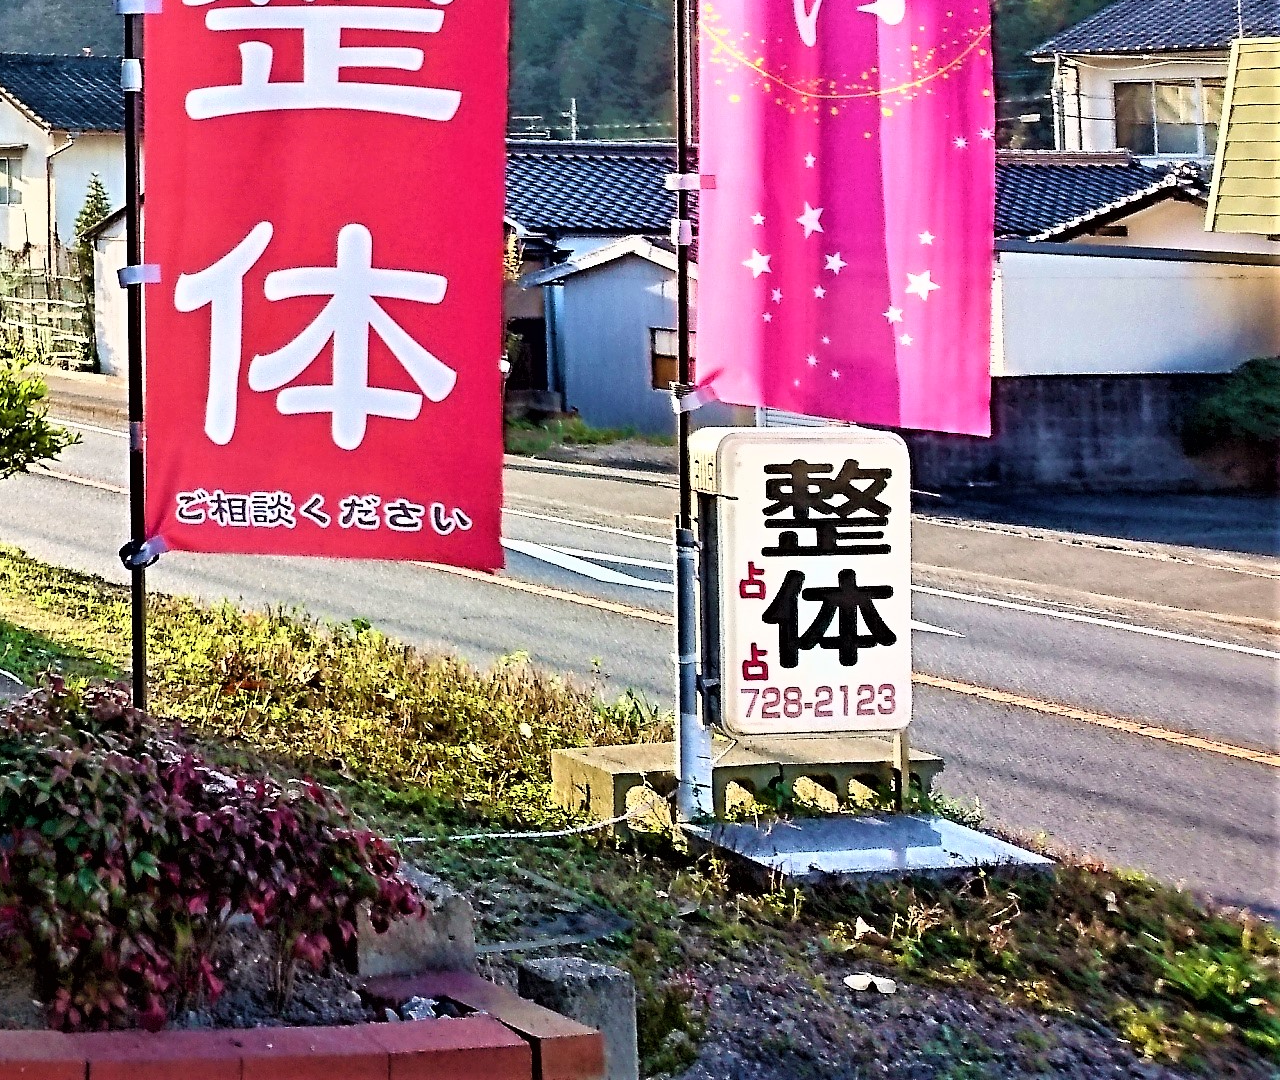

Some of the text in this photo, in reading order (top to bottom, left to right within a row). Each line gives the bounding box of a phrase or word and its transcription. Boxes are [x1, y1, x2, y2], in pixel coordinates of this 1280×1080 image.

[177, 490, 473, 535] ご相談ください
[760, 458, 898, 669] 整体
[740, 683, 896, 719] 728-2123
